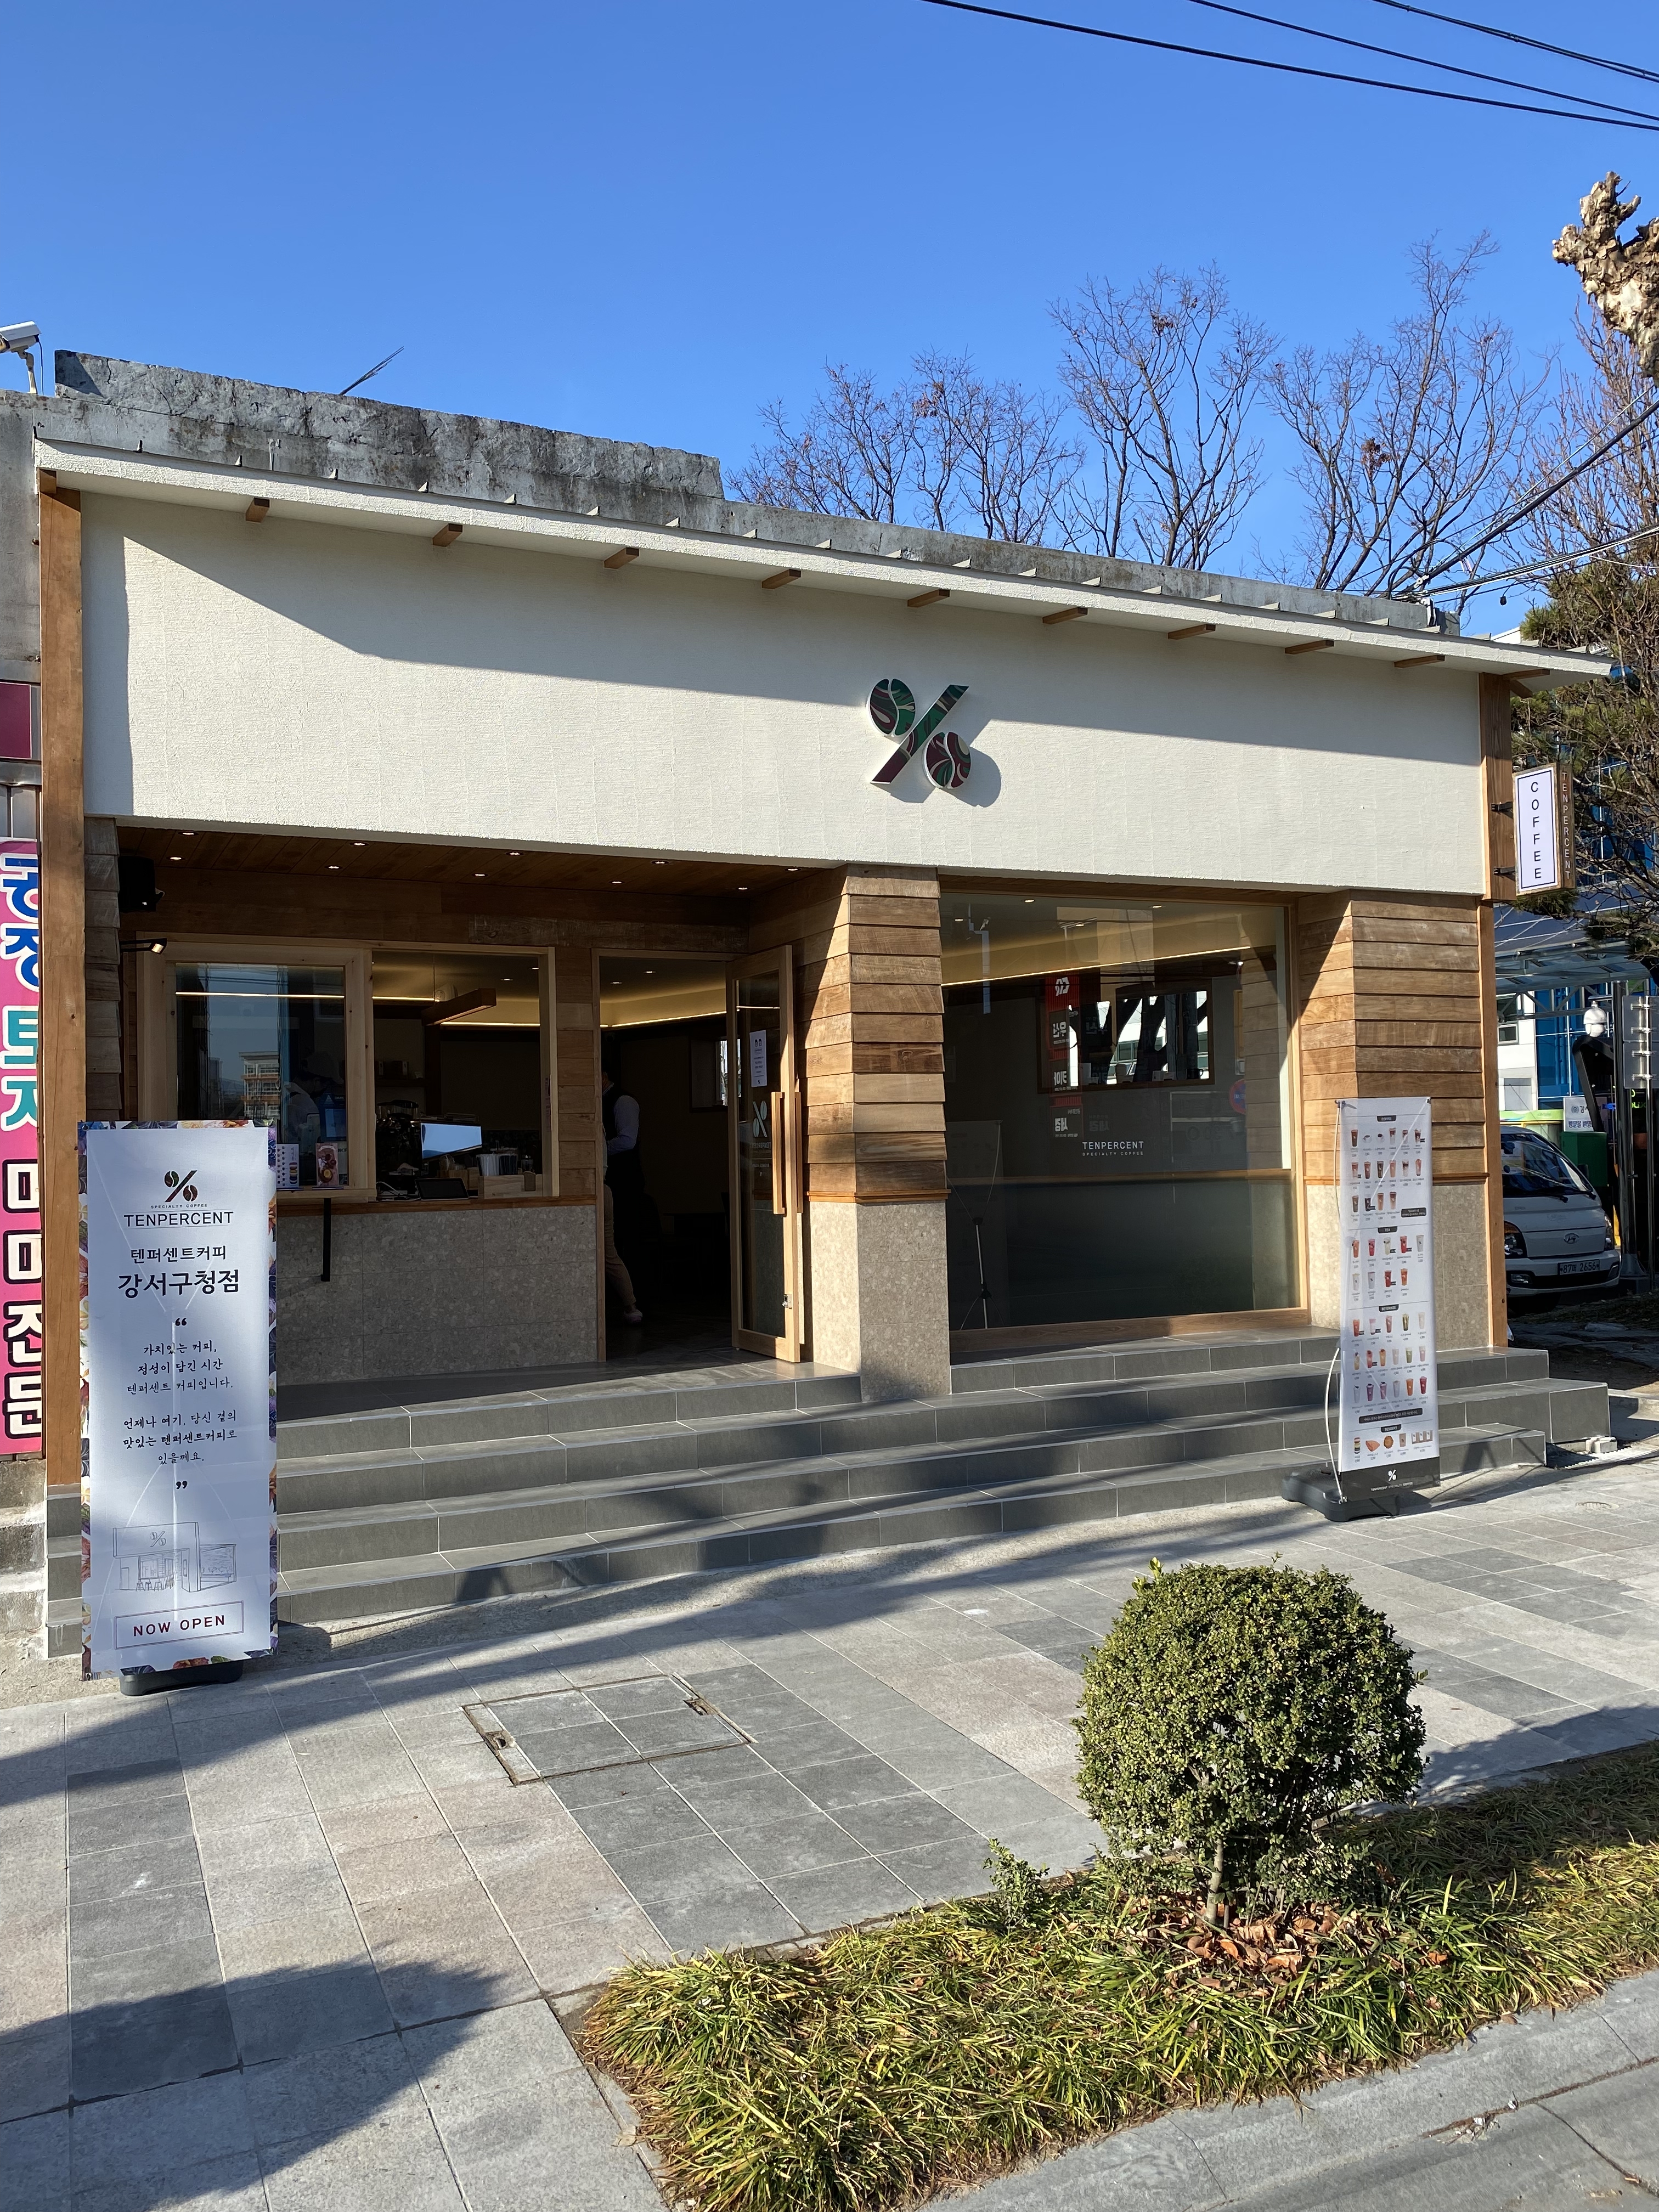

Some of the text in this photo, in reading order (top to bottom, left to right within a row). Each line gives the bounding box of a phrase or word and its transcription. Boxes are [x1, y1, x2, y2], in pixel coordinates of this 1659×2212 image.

[1531, 782, 1541, 879] COFFEE
[1562, 772, 1571, 879] TENPERCENT
[1082, 1141, 1144, 1150] TENPERCENT
[123, 1211, 234, 1227] TENPERCENT
[131, 1245, 227, 1264] 텐퍼센트커피
[1579, 1262, 1596, 1272] 2656
[118, 1269, 239, 1299] 강서구청점
[143, 1340, 217, 1356] 가치있는 커피,
[138, 1357, 223, 1376] 정성이 담긴 시간
[127, 1376, 233, 1395] 텐퍼센트 커피입니다.
[123, 1409, 236, 1430] 언제나 여기, 당신 곁의
[123, 1429, 237, 1449] 맛있는 텐퍼센트커피로
[158, 1451, 204, 1465] 있을께요.
[133, 1615, 225, 1637] NOW OPEN
